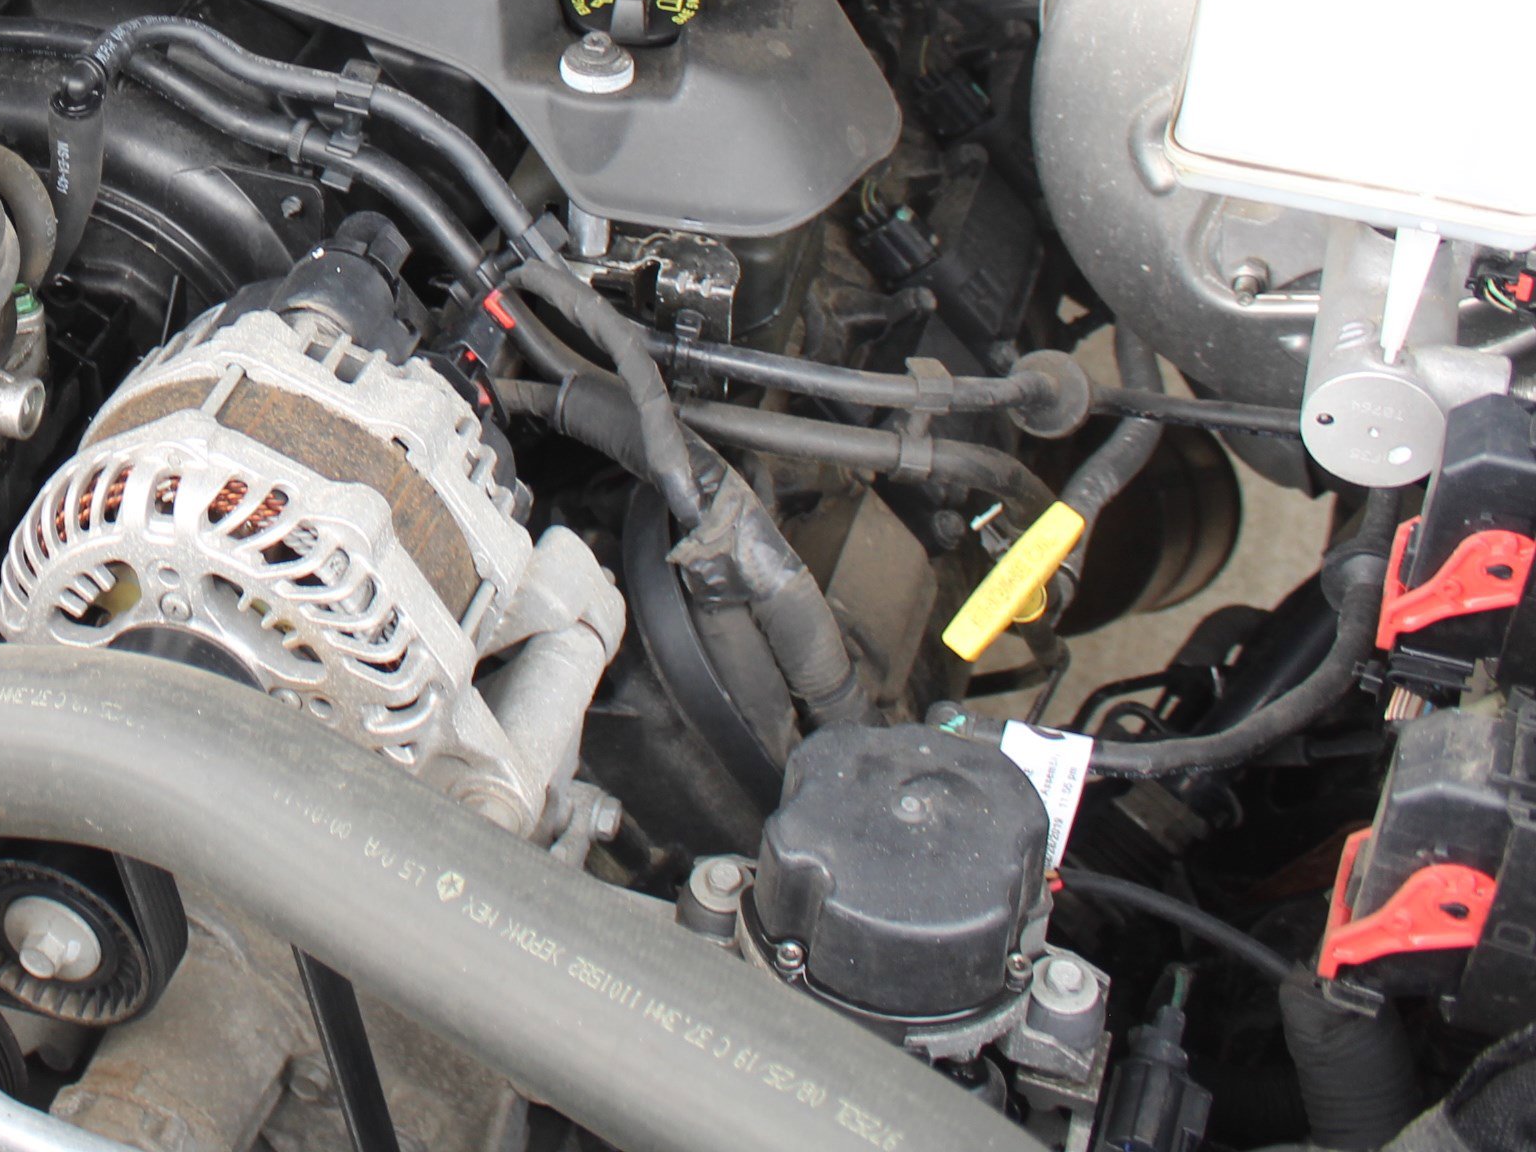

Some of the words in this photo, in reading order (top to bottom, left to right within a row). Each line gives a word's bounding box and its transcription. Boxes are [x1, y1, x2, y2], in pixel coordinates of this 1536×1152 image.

[55, 692, 67, 709] C
[462, 894, 503, 929] MEX
[714, 1034, 732, 1060] C
